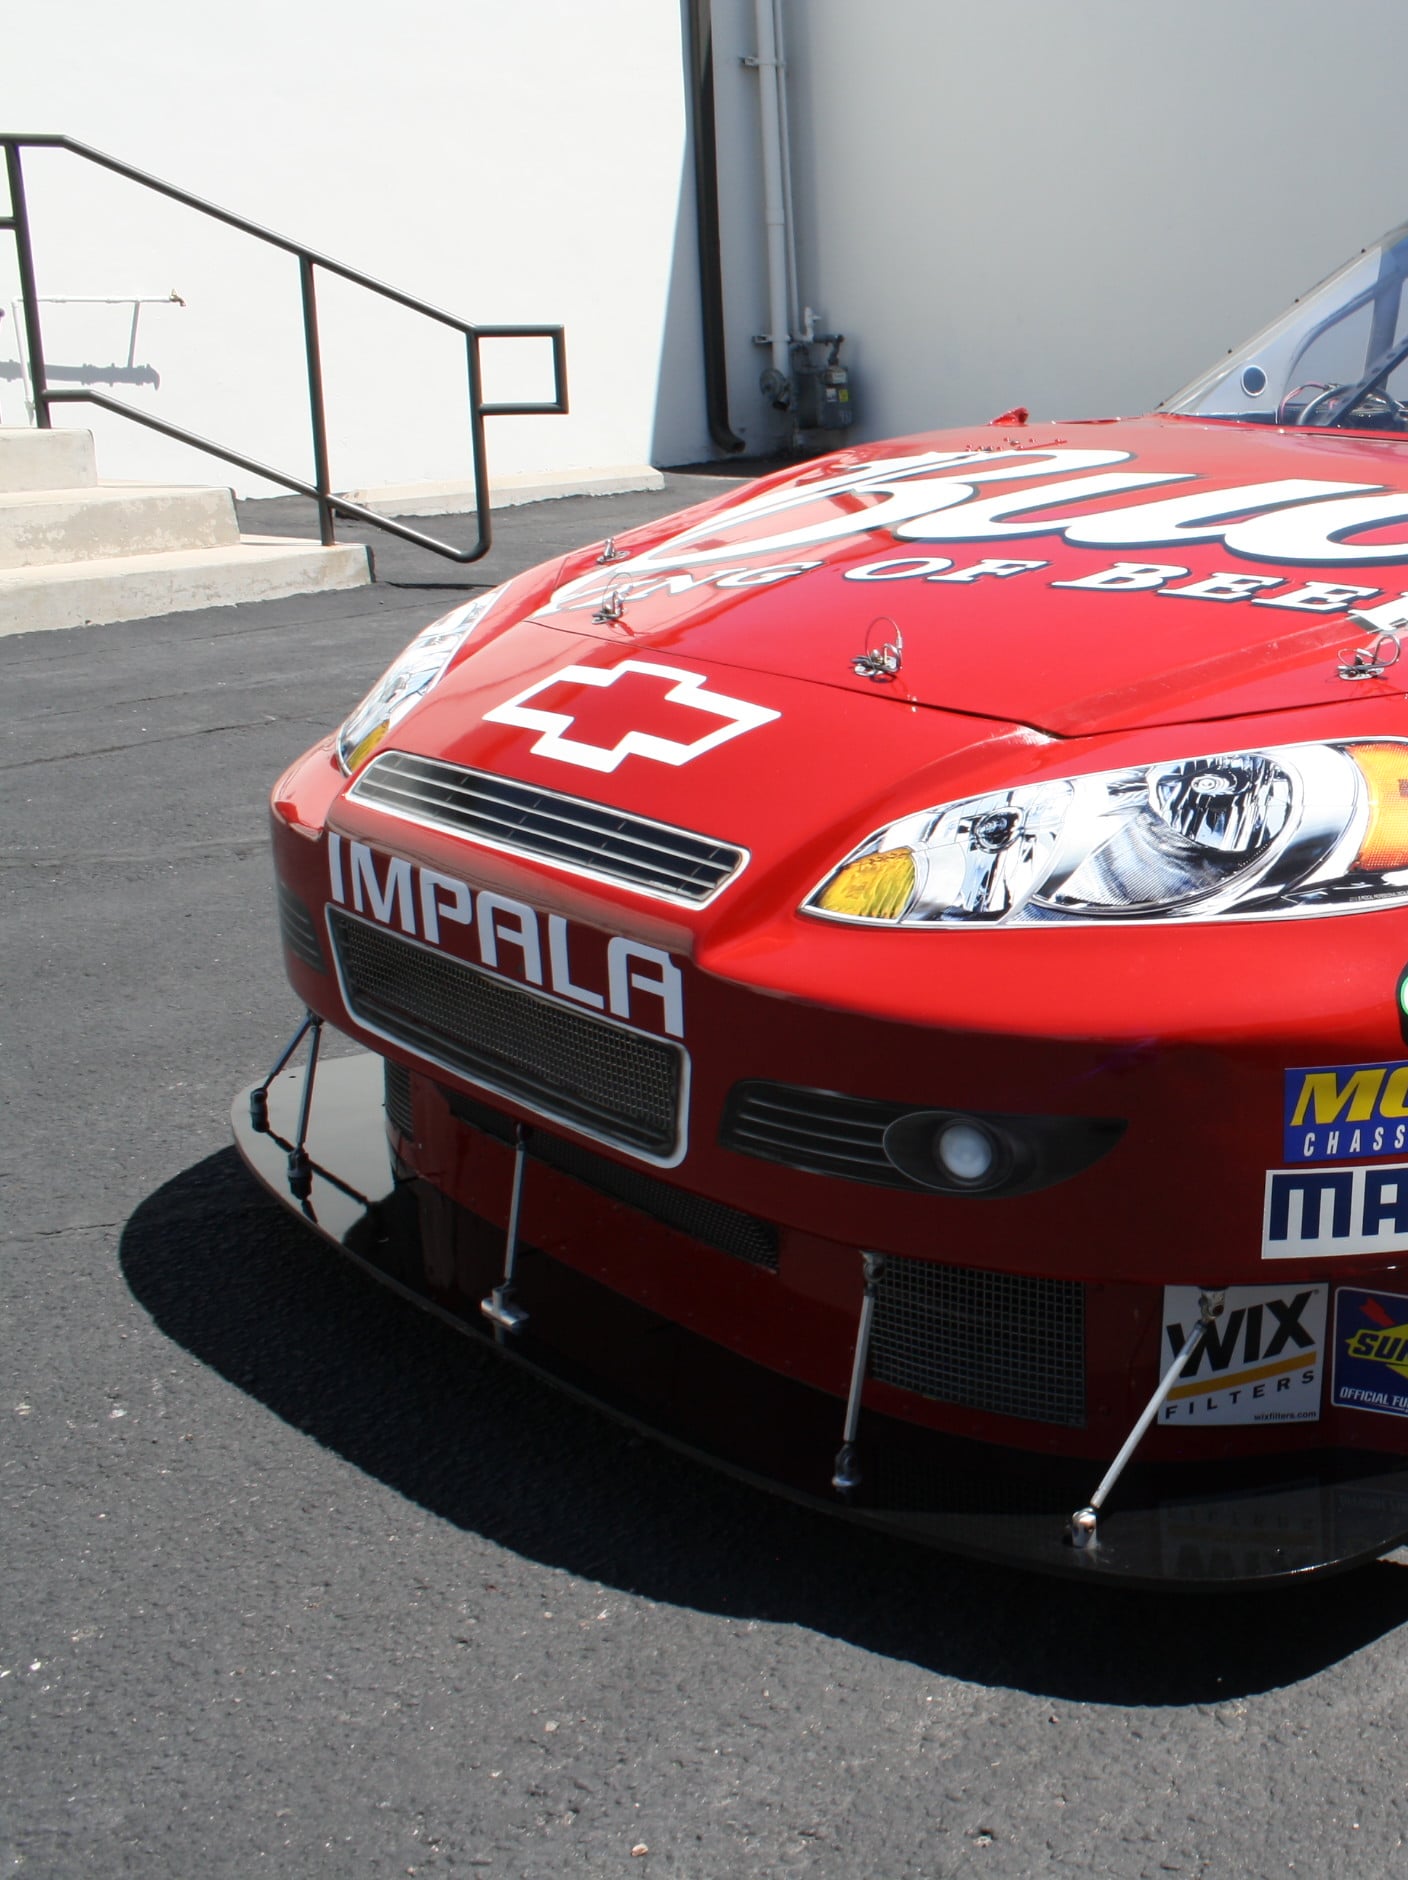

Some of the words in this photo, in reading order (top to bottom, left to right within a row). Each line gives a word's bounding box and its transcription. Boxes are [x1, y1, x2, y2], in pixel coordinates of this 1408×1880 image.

[843, 556, 1050, 583] OF
[328, 832, 685, 1038] IMPALA
[1166, 1290, 1316, 1378] WIX
[1165, 1370, 1315, 1420] FILTERS
[1339, 1386, 1389, 1406] OFFICIAL
[1253, 1410, 1317, 1422] wixfilters.com
